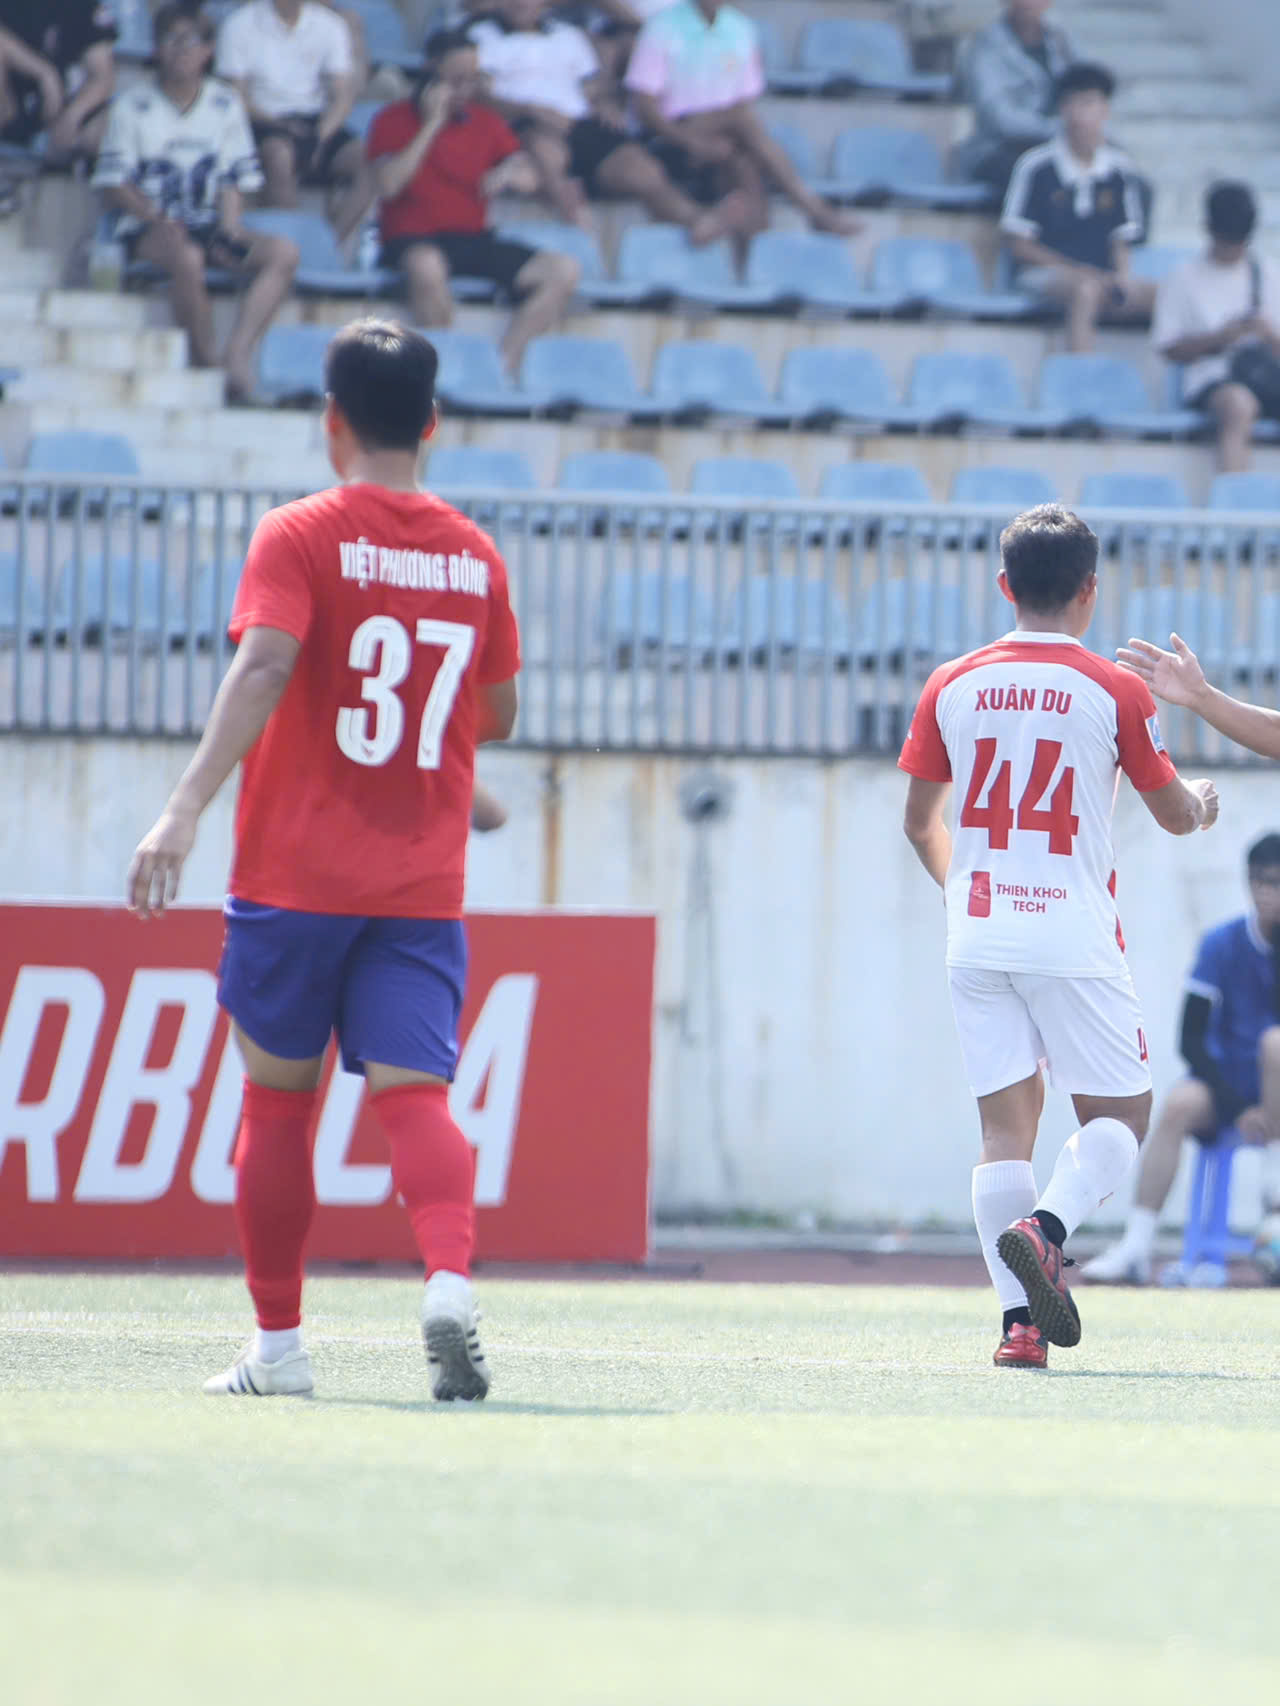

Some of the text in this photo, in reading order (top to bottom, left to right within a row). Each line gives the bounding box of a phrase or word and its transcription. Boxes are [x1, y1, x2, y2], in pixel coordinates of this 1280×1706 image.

[335, 614, 476, 770] 37
[975, 684, 1073, 715] XUÂN DU
[960, 737, 1080, 857] 44
[996, 882, 1030, 899] THIEN
[1033, 885, 1068, 901] KHOI
[1013, 900, 1047, 914] TECH
